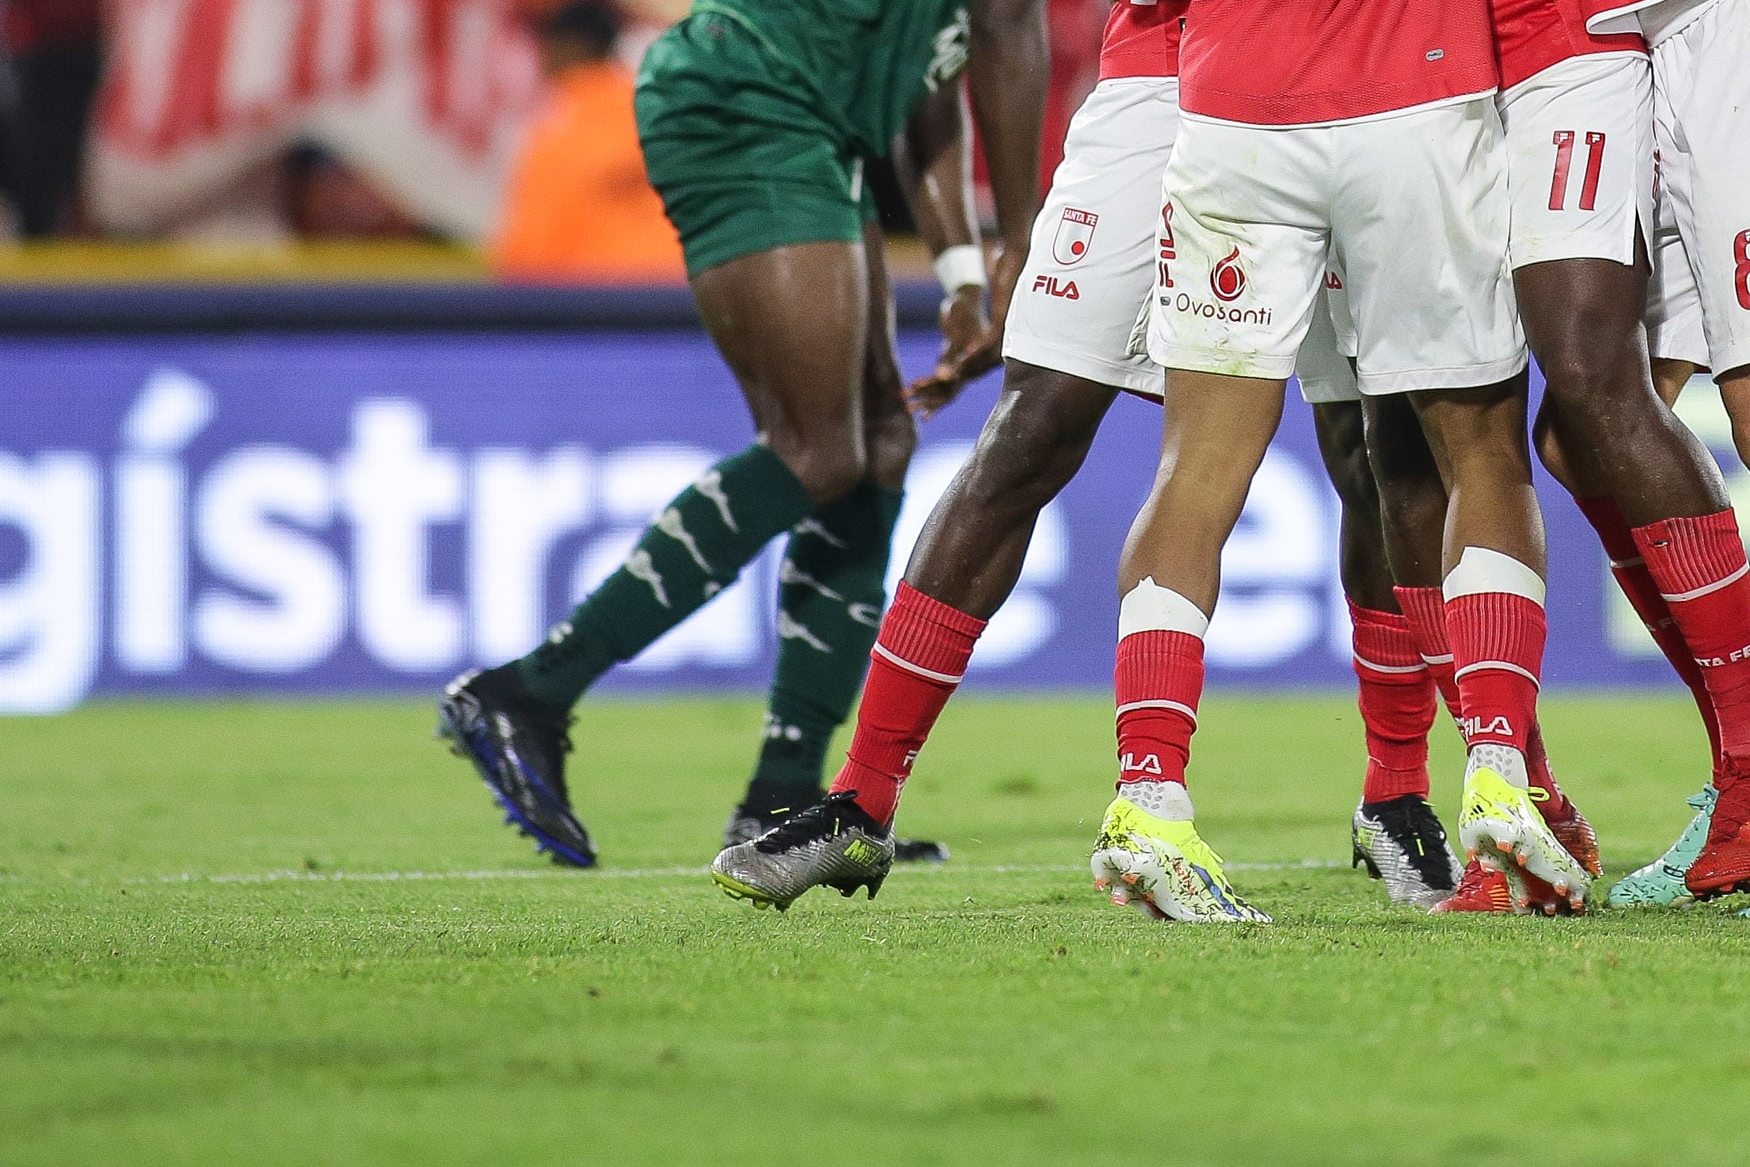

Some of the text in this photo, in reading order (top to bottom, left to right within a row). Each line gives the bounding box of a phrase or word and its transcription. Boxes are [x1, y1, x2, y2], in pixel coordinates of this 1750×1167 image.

[1547, 129, 1607, 212] 11
[1086, 214, 1098, 226] FE
[1032, 275, 1081, 301] FILA
[1176, 293, 1274, 326] Ovosanti
